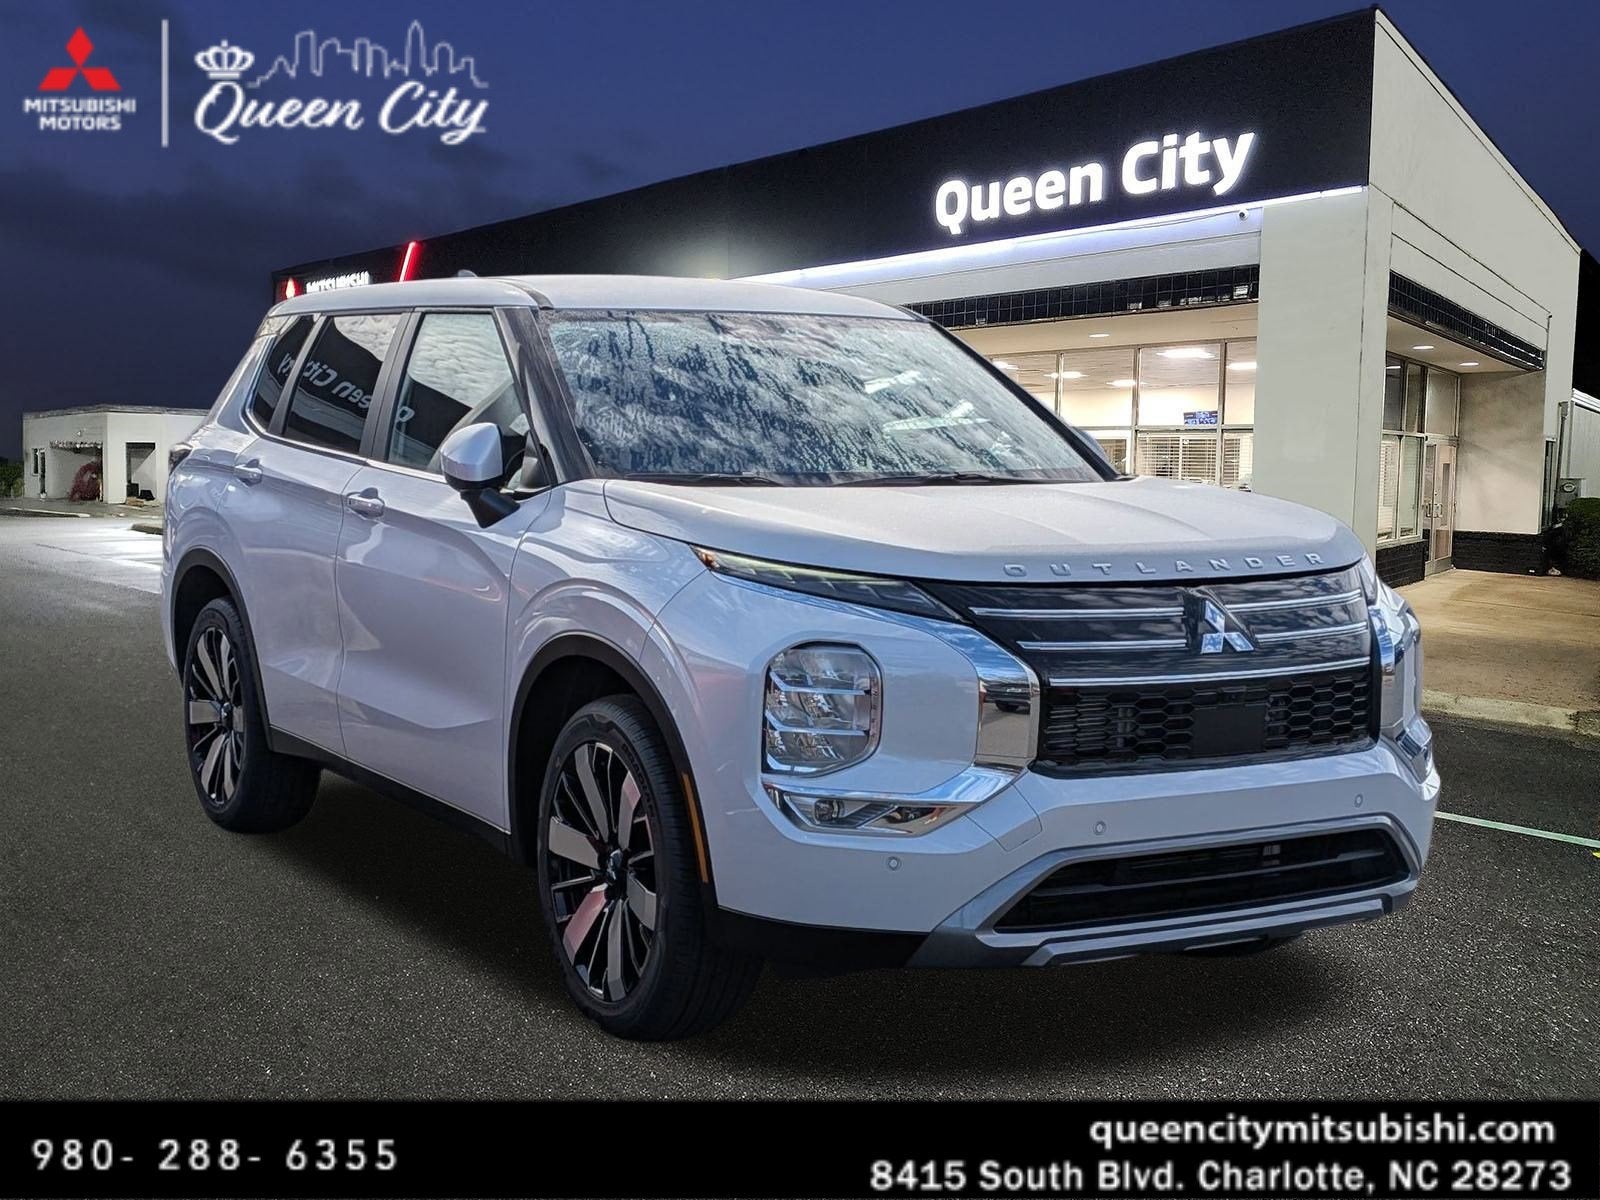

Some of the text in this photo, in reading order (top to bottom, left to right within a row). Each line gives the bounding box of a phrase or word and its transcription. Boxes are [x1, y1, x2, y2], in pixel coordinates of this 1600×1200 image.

[935, 131, 1255, 235] Queen City
[1003, 552, 1325, 577] OUTLANDER
